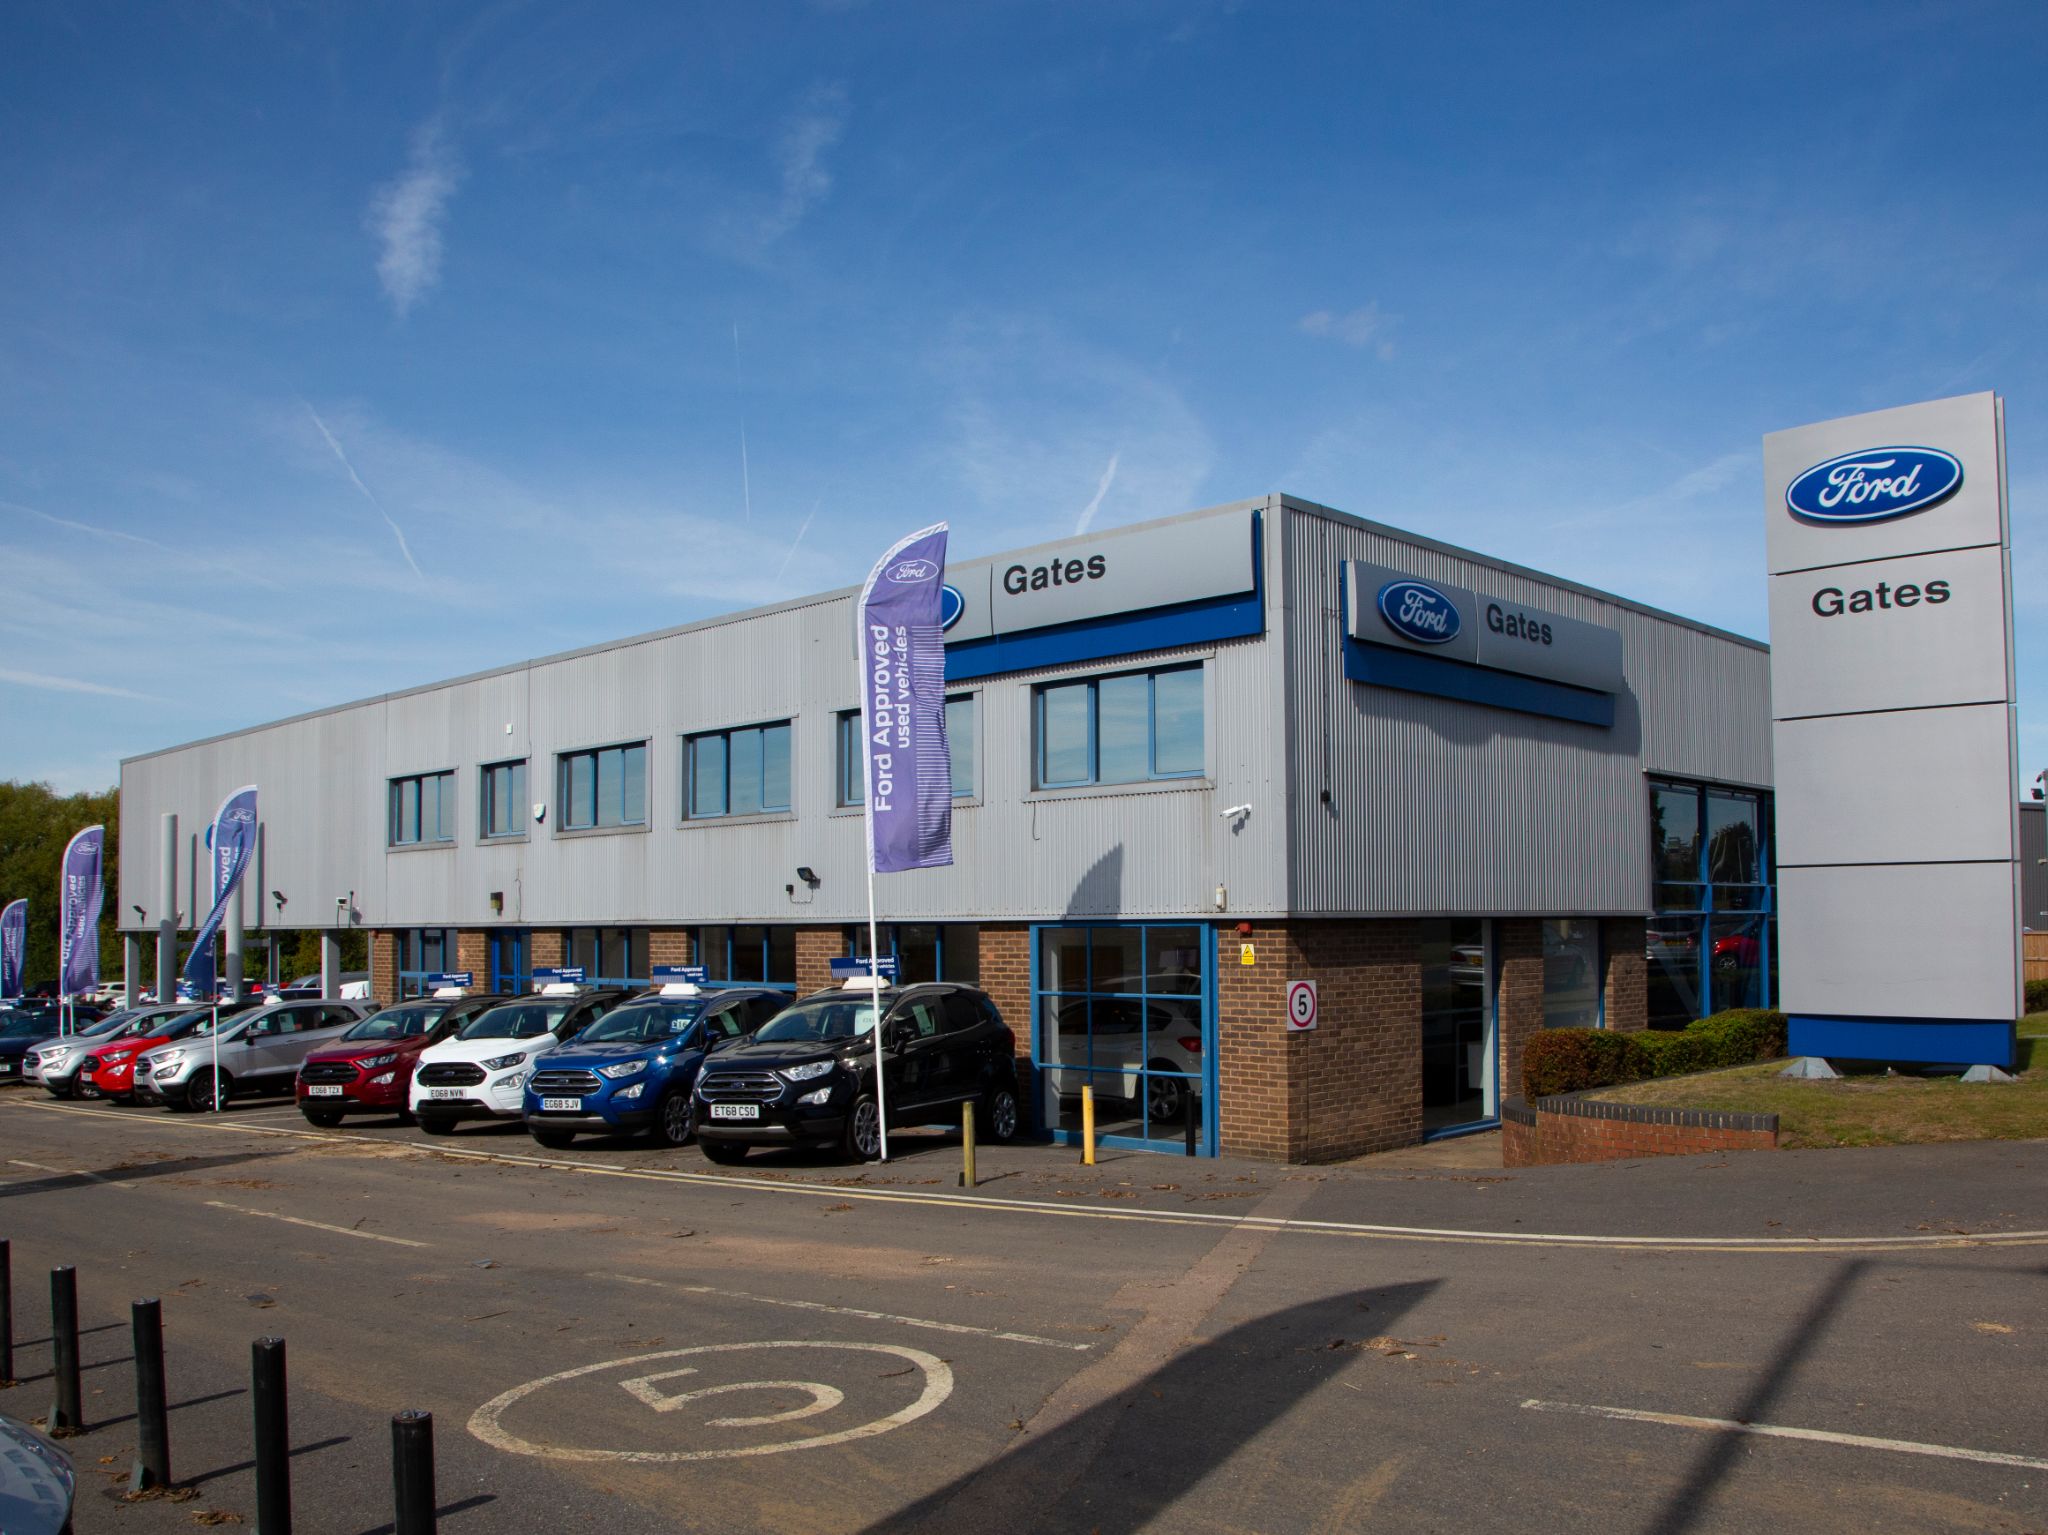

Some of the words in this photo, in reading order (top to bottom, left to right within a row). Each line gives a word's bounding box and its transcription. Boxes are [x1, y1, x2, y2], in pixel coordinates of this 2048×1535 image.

[1819, 459, 1923, 507] Ford
[896, 562, 927, 580] Ford
[1003, 555, 1106, 595] Gates
[1400, 589, 1448, 633] Ford
[1812, 580, 1950, 617] Gates
[1486, 603, 1553, 645] Gates
[892, 625, 910, 700] vehicles
[870, 625, 894, 747] Approved
[894, 703, 910, 749] used
[873, 753, 893, 812] Ford
[1298, 994, 1307, 1016] 5
[449, 1089, 464, 1097] NVN
[544, 1099, 563, 1109] EG68
[564, 1099, 579, 1109] SJV
[715, 1106, 737, 1116] ET68
[739, 1106, 756, 1116] CSO
[618, 1367, 844, 1426] 5
